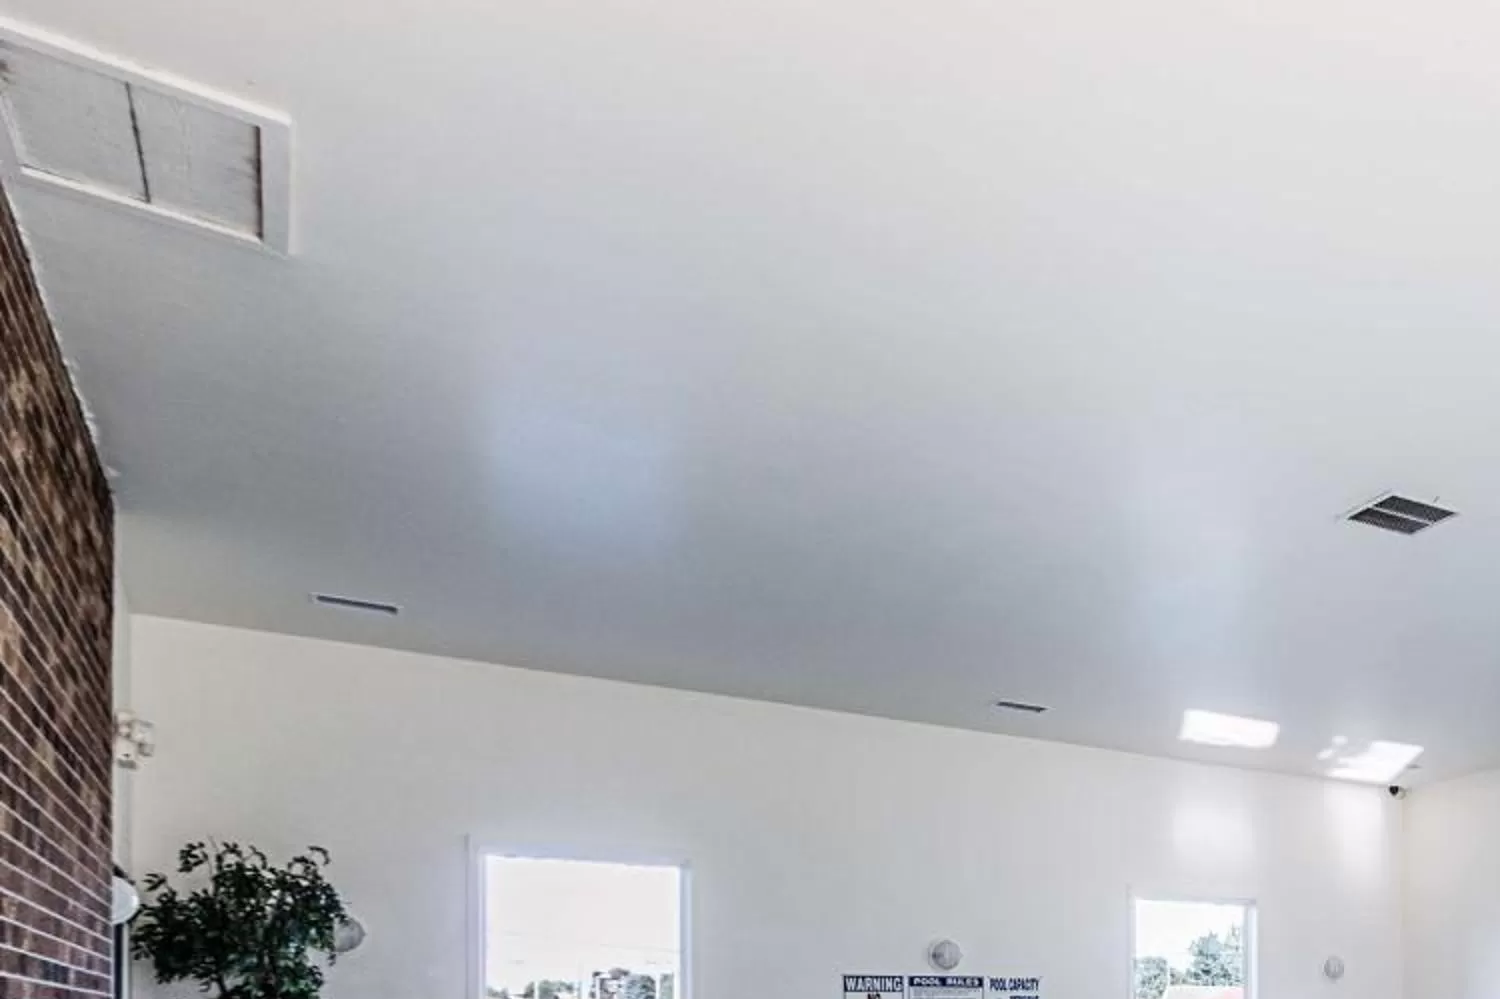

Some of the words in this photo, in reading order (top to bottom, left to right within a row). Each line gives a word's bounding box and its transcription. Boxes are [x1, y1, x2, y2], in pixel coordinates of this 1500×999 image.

[845, 977, 903, 991] WARNING
[912, 978, 941, 986] POOL
[989, 977, 1007, 991] POOL
[1008, 977, 1040, 991] CAPACITY
